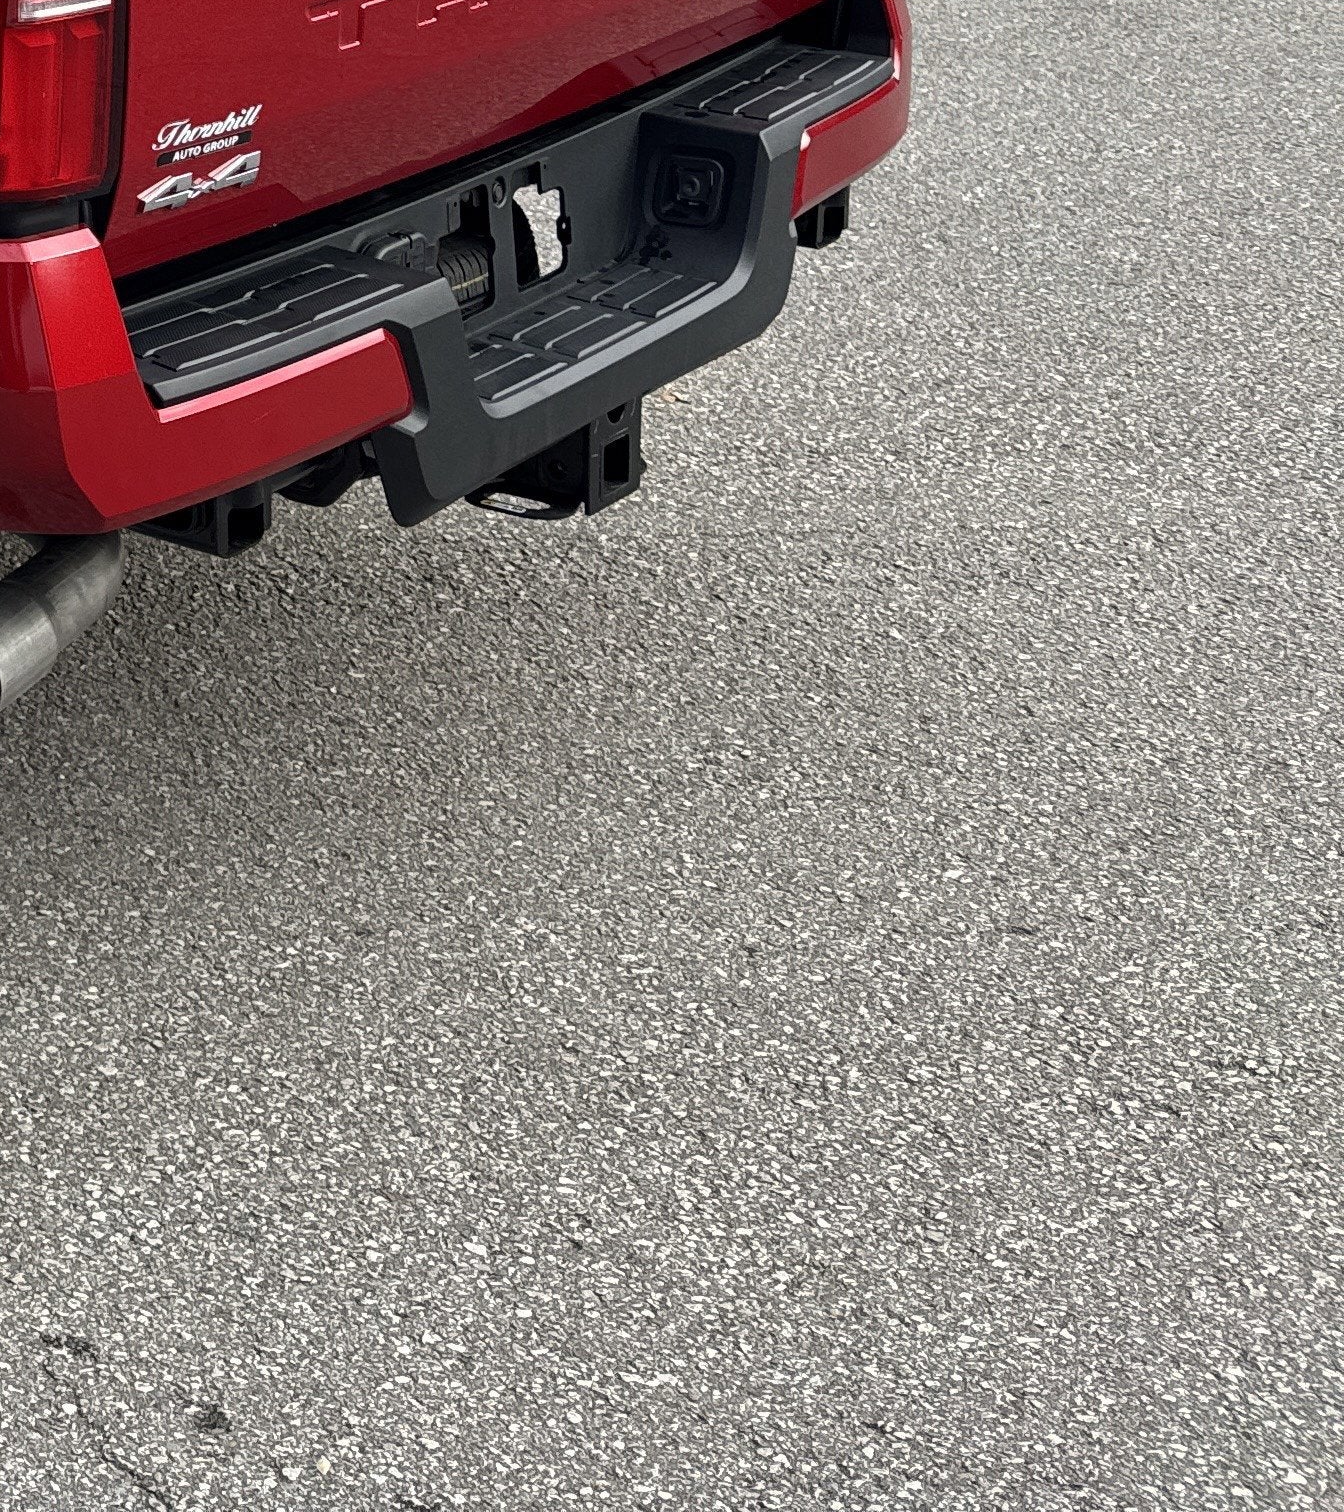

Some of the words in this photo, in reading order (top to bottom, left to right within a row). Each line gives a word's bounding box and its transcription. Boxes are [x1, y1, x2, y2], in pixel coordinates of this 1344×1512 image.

[152, 104, 263, 150] Thornhill
[172, 144, 202, 162] AUTO
[203, 135, 239, 154] GROUP
